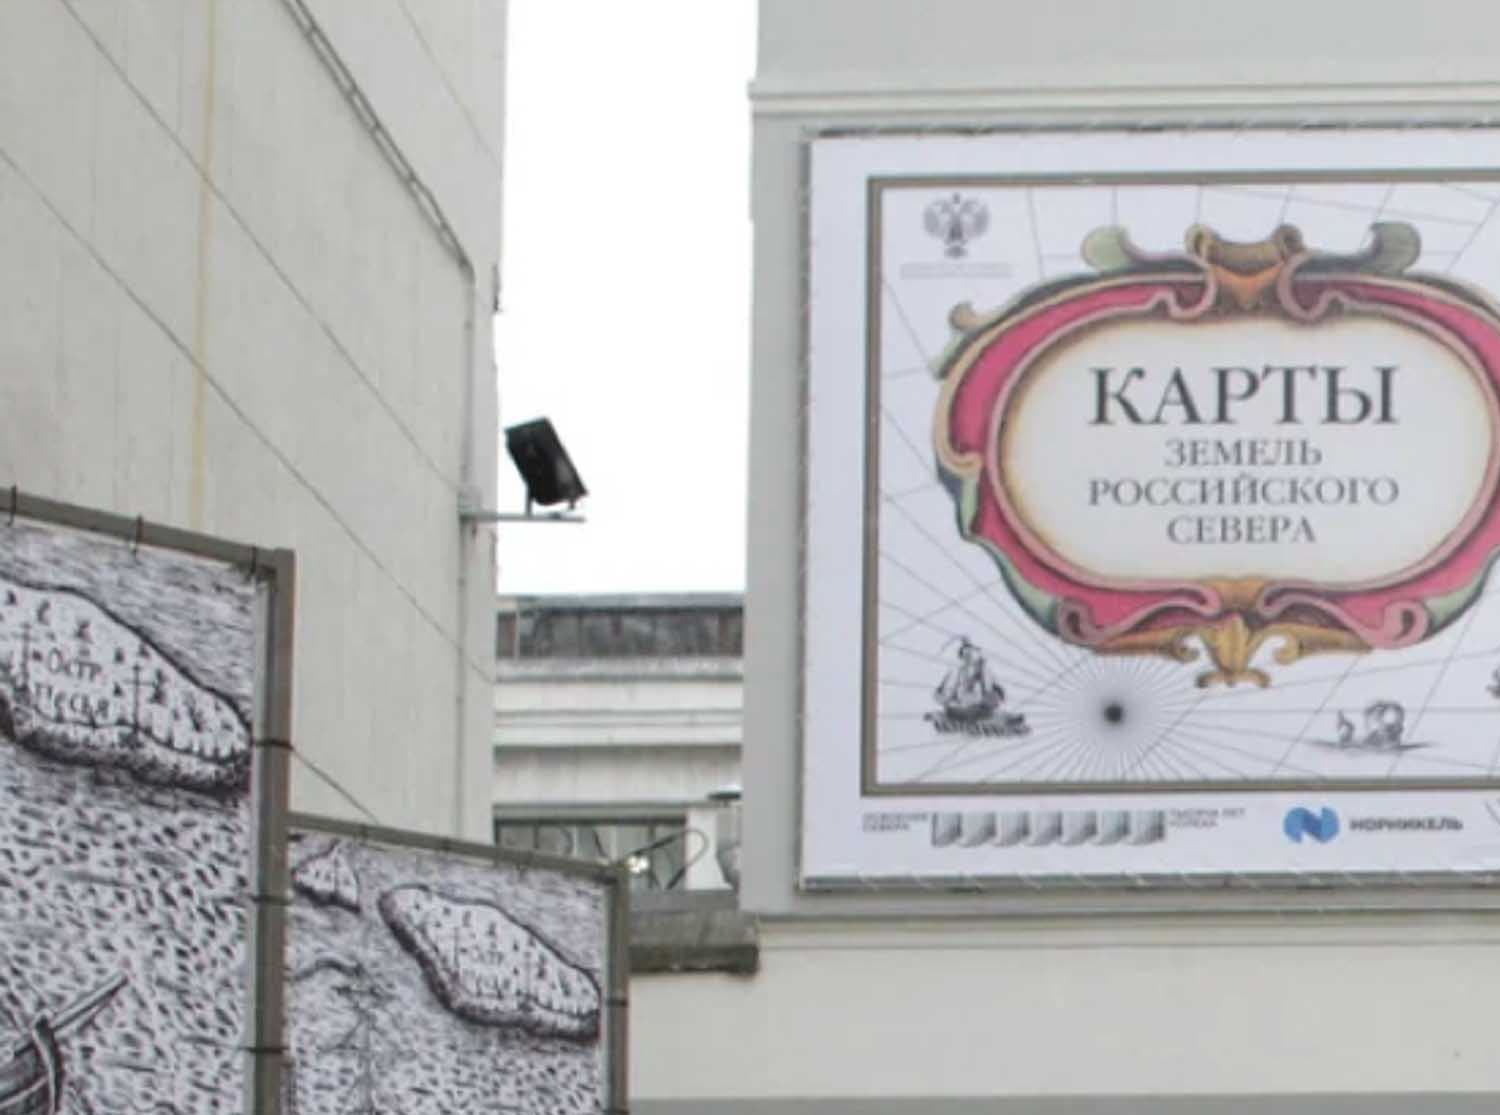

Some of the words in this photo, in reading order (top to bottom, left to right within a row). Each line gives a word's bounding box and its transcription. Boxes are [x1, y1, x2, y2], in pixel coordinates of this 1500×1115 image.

[1089, 364, 1398, 425] КАРТЫ
[1165, 438, 1323, 467] ЗЕМЕЛЬ
[1088, 471, 1400, 507] РОССИЙСКОГО
[1166, 515, 1316, 545] СЕВЕРА
